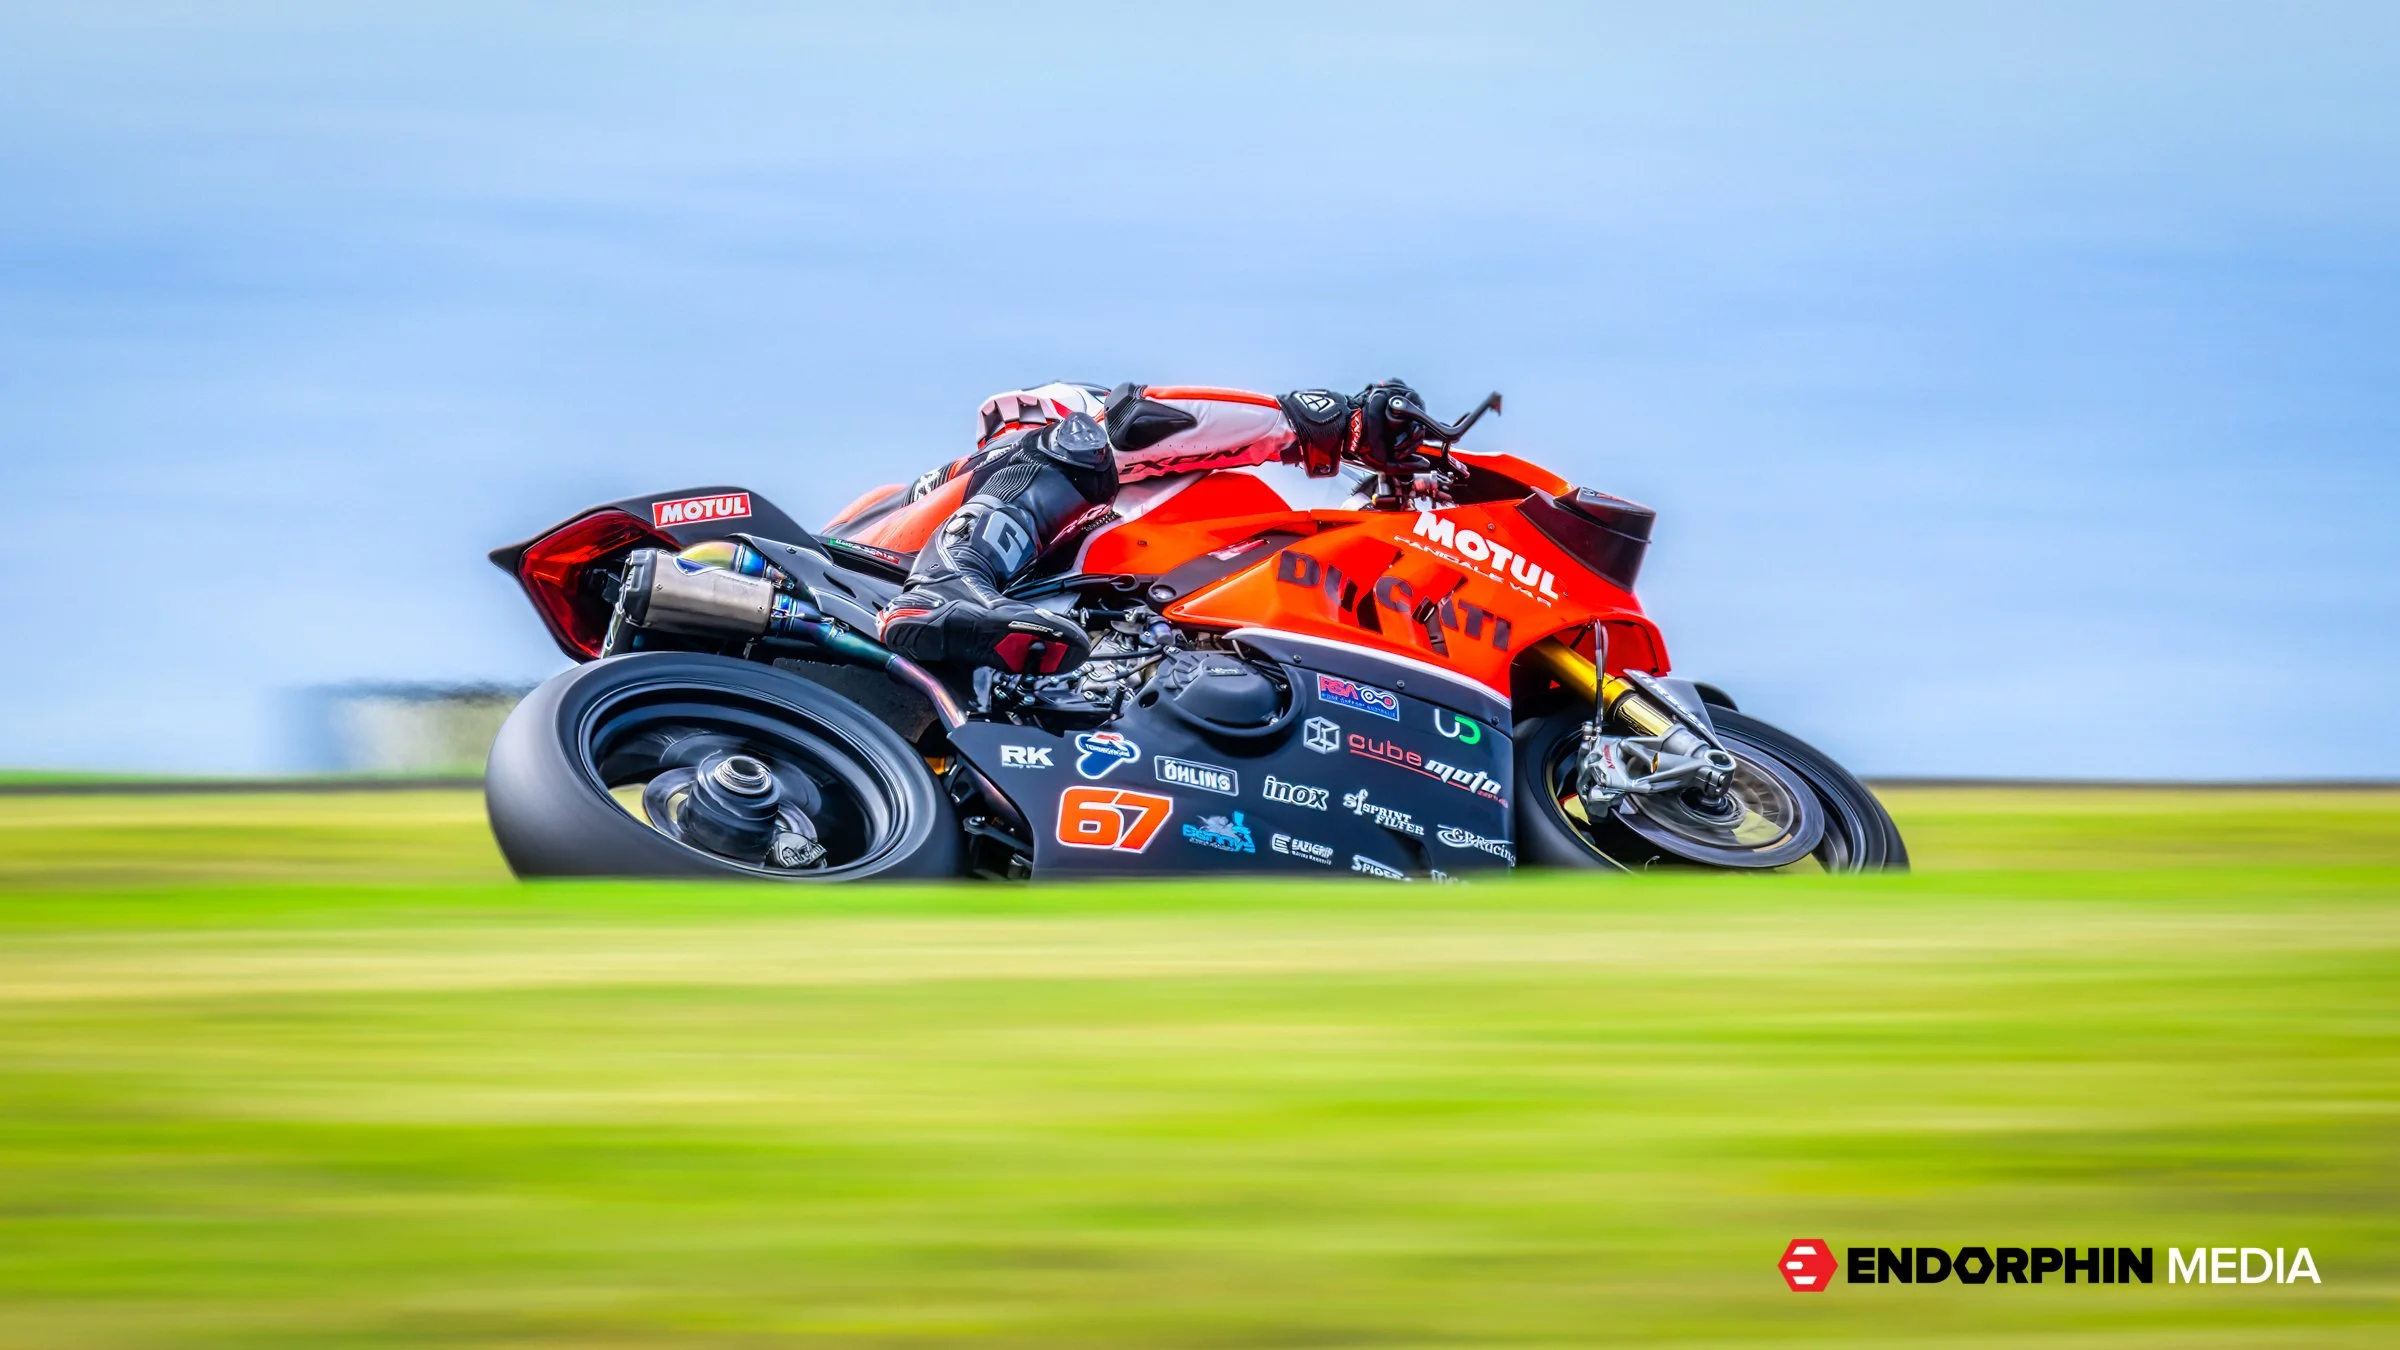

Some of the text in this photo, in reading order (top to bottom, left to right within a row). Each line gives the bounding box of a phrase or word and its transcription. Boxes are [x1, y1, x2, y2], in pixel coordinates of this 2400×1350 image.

[660, 498, 745, 524] MOTUL
[1413, 511, 1558, 600] MOTUL
[1001, 744, 1055, 767] RK
[1348, 733, 1502, 794] cube moto
[1263, 776, 1329, 811] inox
[1056, 786, 1174, 854] 67
[1363, 803, 1412, 823] SPRINT
[1374, 812, 1425, 836] FILTER
